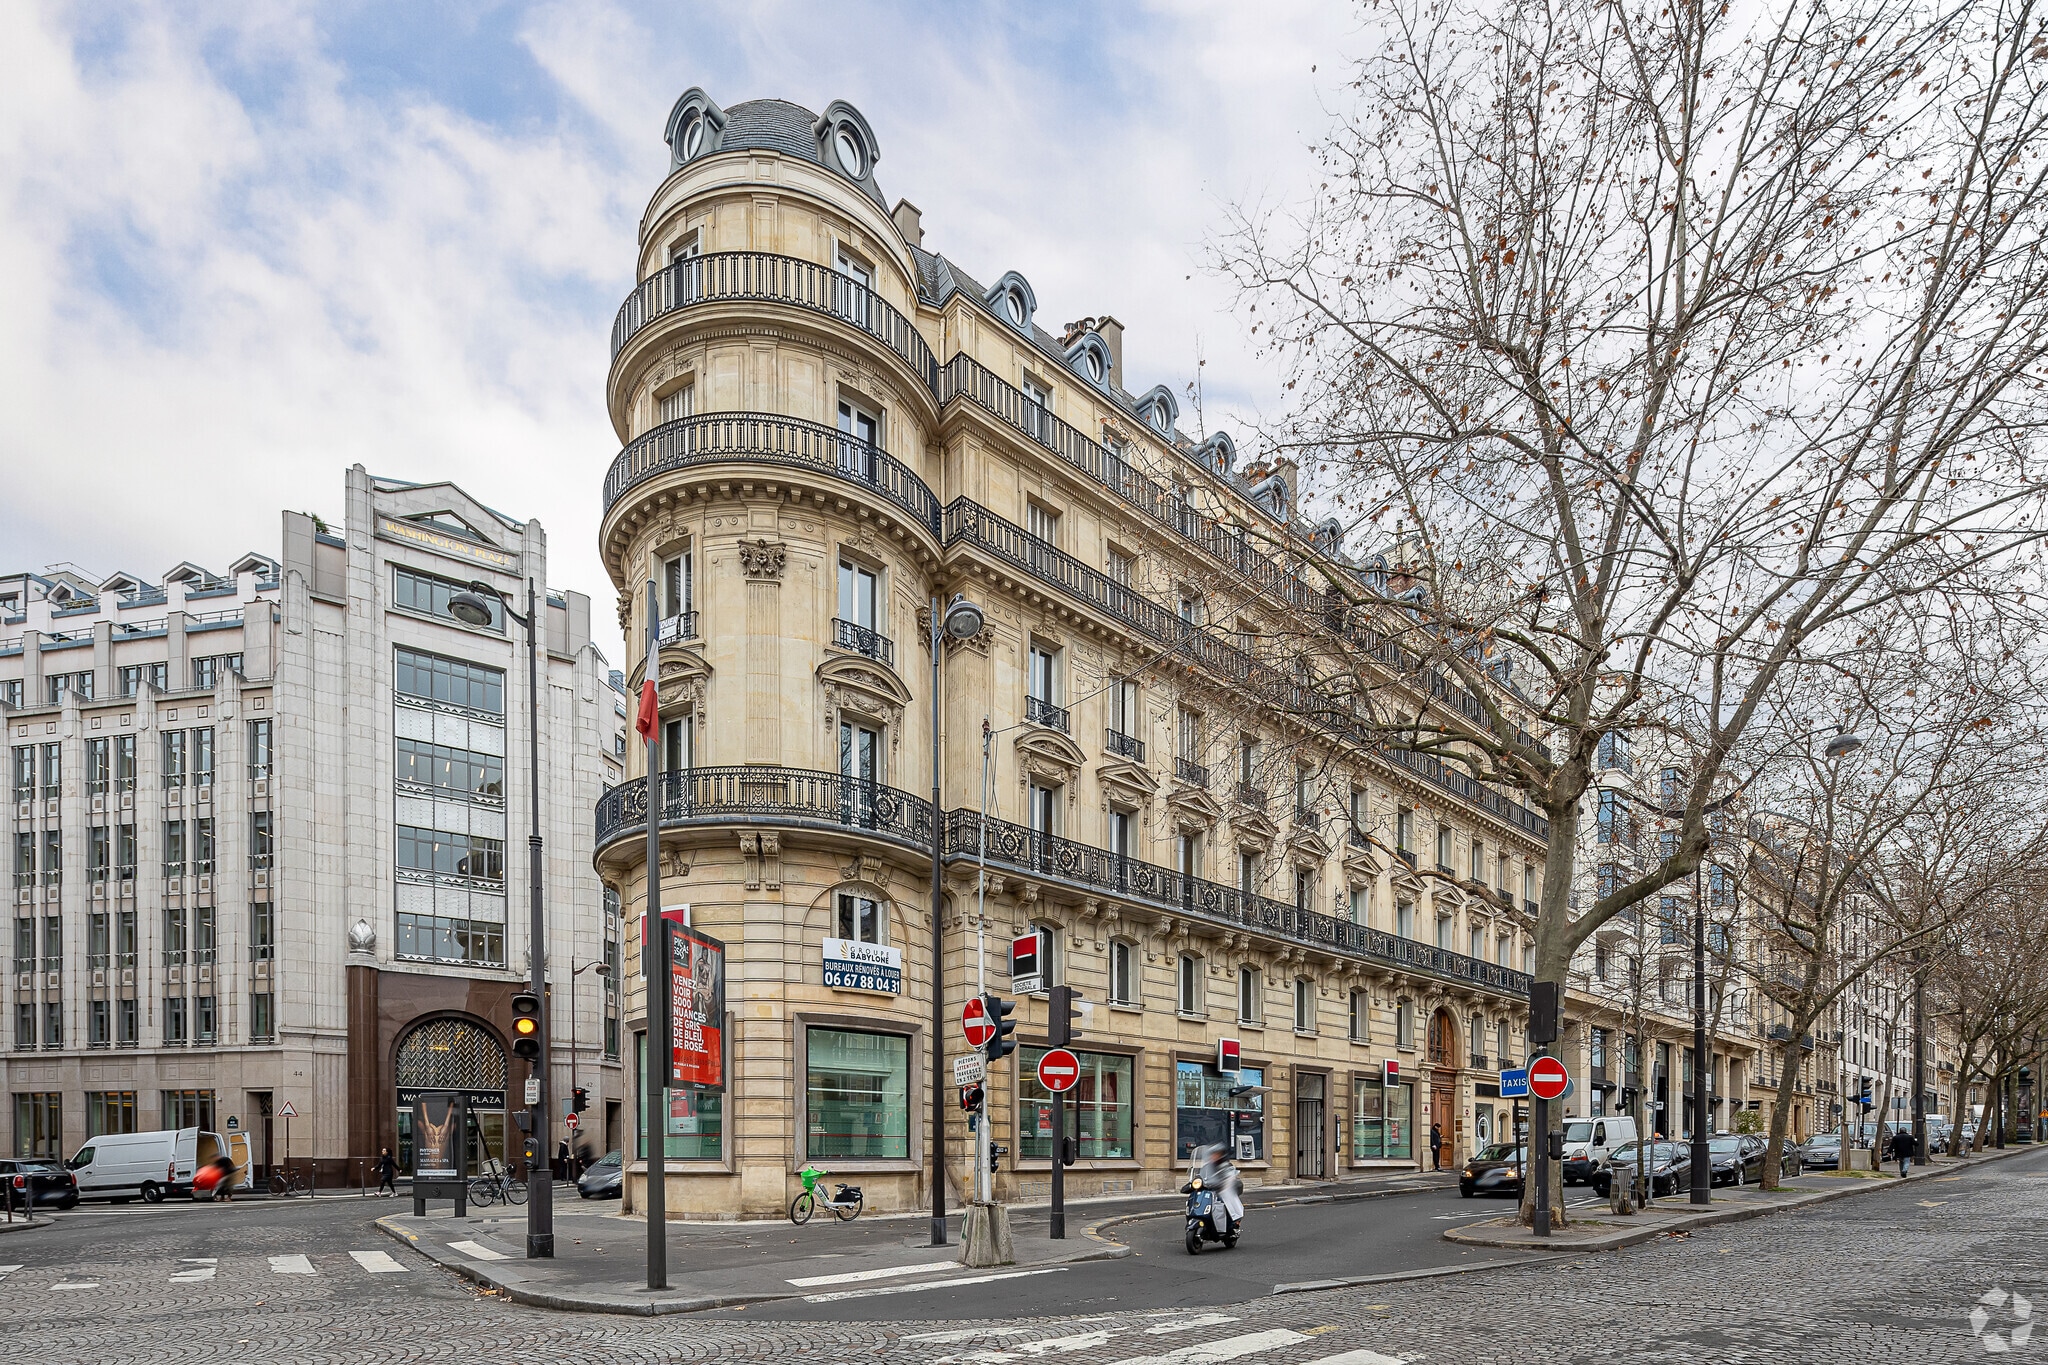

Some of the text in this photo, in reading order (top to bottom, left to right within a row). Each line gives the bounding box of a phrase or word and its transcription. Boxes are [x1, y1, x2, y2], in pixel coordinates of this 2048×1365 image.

[386, 521, 511, 565] WASHINGTON PLAZA
[850, 946, 889, 958] GROUPE
[850, 952, 889, 964] BABYLONE
[825, 961, 854, 972] BUREAUX
[855, 962, 880, 976] RÉNOVÉS
[885, 969, 900, 979] LOUER
[673, 973, 697, 990] VENEZ
[825, 971, 900, 993] 06 67 88 04 31
[673, 984, 691, 998] VOIR
[673, 996, 691, 1009] 5000
[673, 1006, 707, 1023] NUANCES
[673, 1016, 703, 1033] DE GRIS,
[673, 1026, 704, 1044] DE BLEU,
[673, 1037, 683, 1049] DE
[956, 1062, 980, 1071] ATTENTION
[958, 1056, 977, 1065] PIÉTONS
[956, 1067, 981, 1077] TRAVERSEZ
[1502, 1077, 1527, 1088] TAXIS
[471, 1096, 502, 1104] PLAZA
